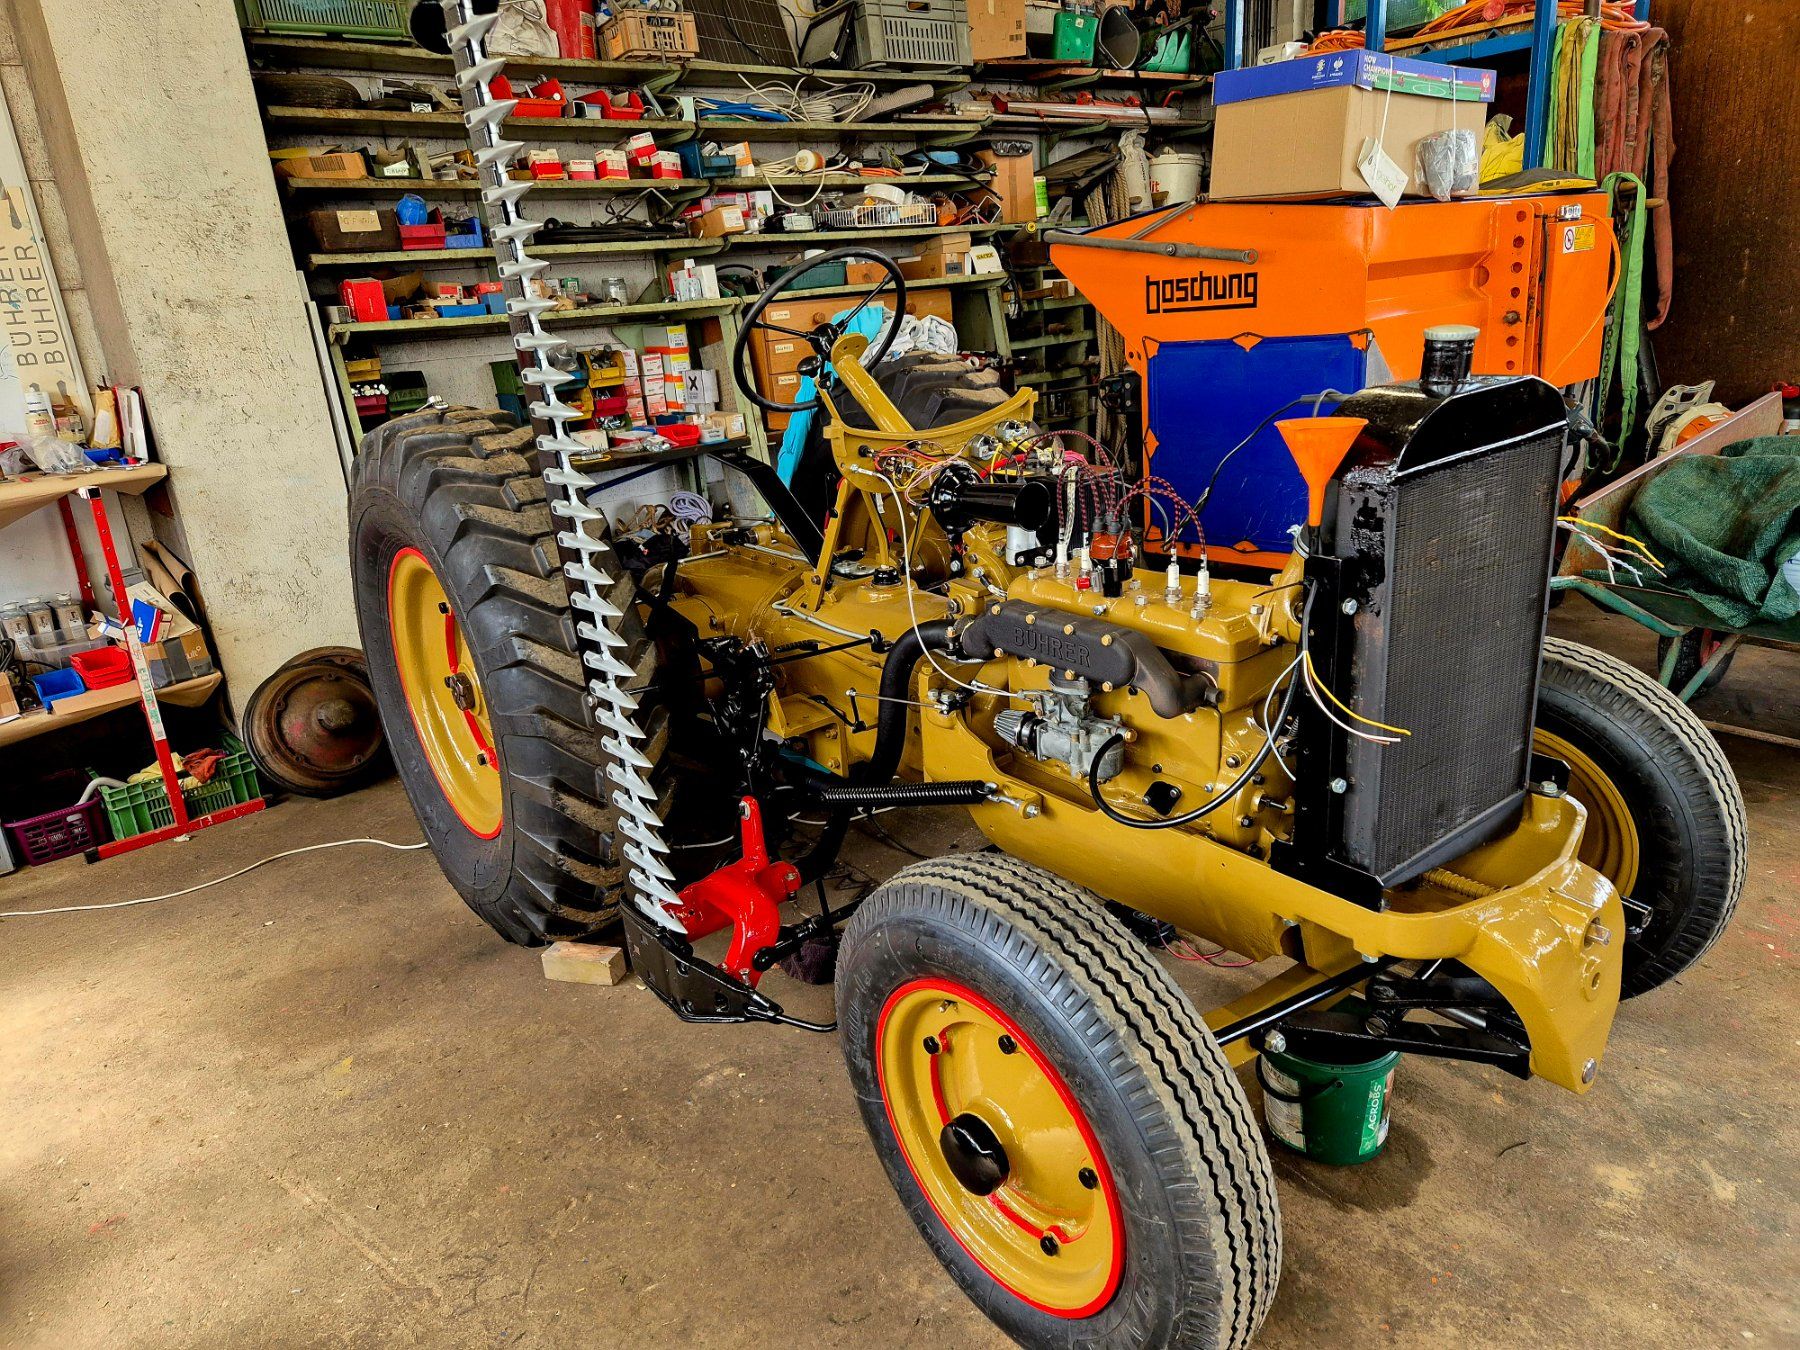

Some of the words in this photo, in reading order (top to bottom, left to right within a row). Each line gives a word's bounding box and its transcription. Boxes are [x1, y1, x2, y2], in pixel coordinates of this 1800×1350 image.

[1363, 64, 1391, 76] CHAMPION
[14, 245, 65, 364] BÜHRER
[1146, 271, 1258, 314] boschung
[1367, 1084, 1382, 1131] AGROBS
